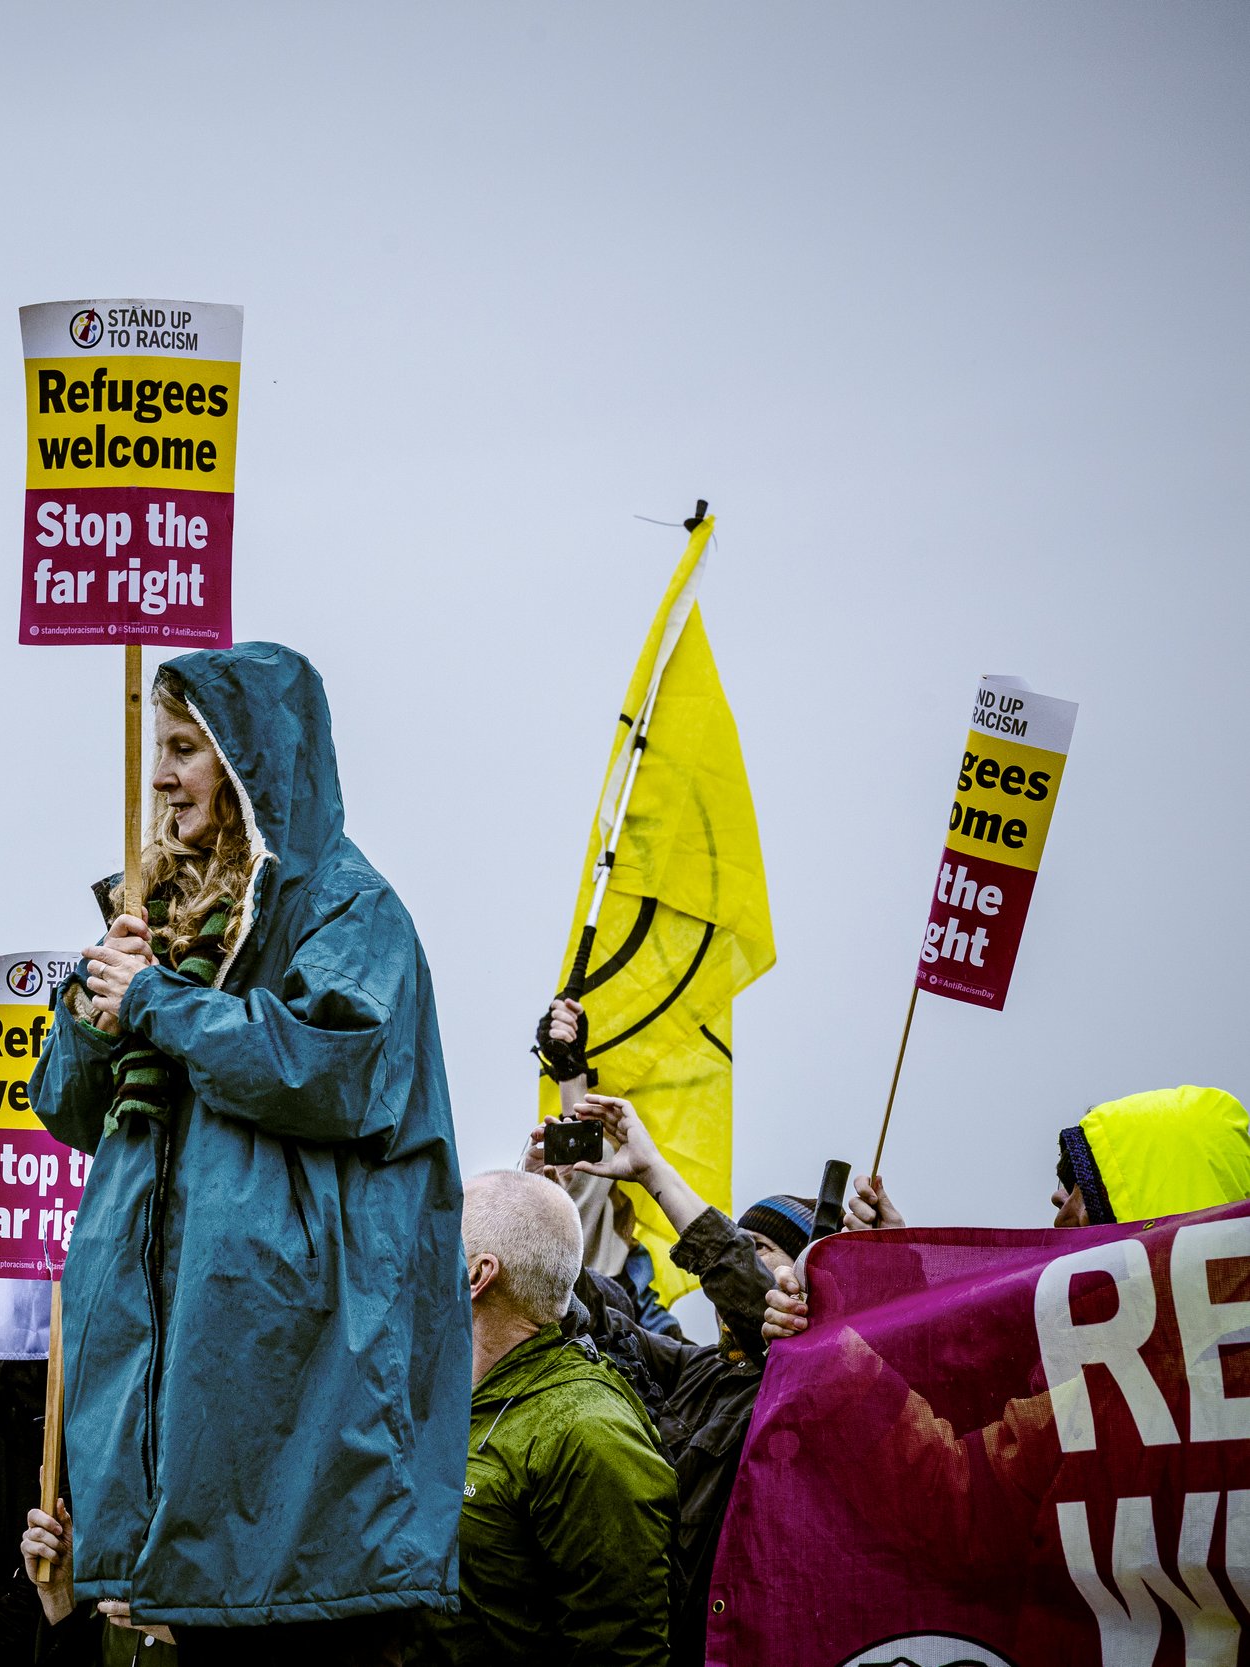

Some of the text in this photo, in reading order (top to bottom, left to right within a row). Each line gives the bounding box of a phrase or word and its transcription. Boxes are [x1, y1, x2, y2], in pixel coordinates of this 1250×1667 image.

[108, 308, 192, 329] STAND UP
[108, 330, 198, 351] TO RACISM
[38, 367, 229, 423] Refugees
[38, 424, 217, 473] welcome
[35, 501, 208, 557] Stop the
[34, 558, 204, 615] far right
[41, 626, 104, 635] standuptoracismuk
[999, 695, 1024, 715] UP
[937, 862, 1004, 916] the
[47, 961, 77, 979] STA
